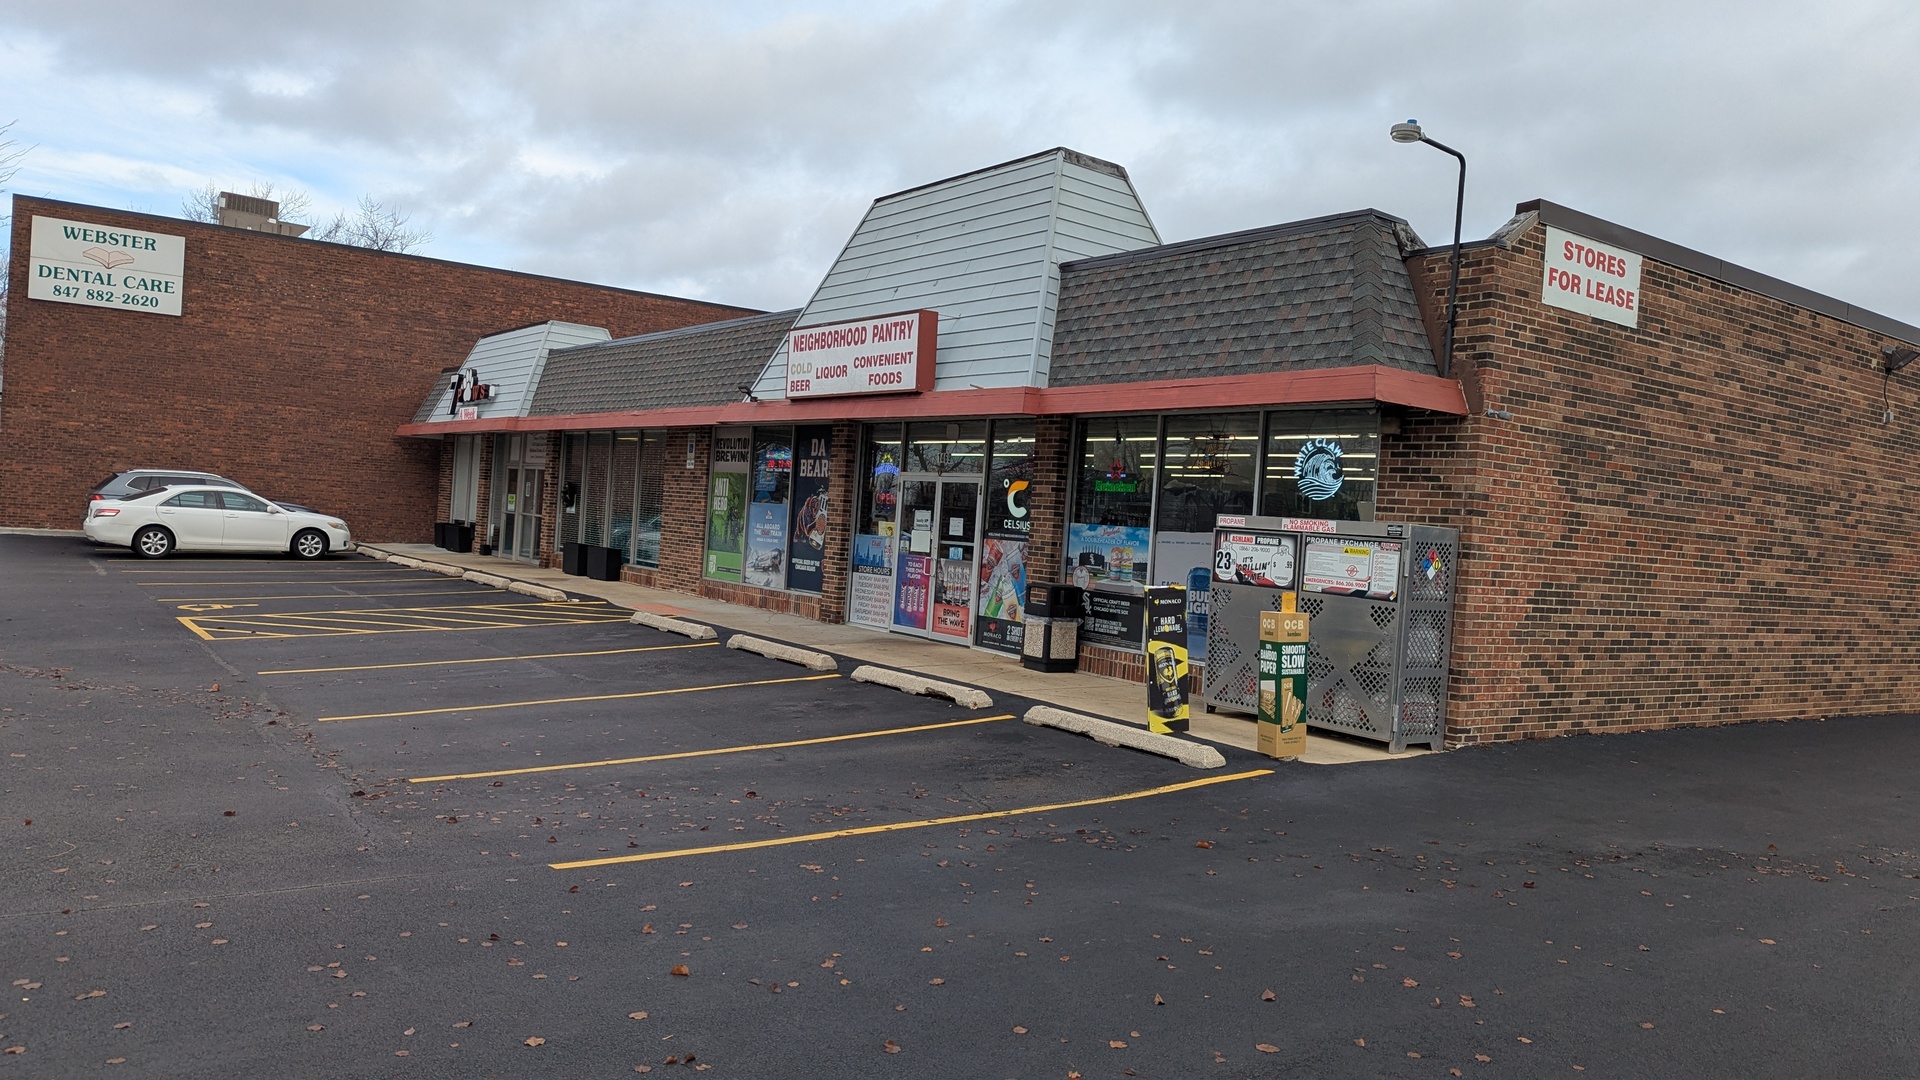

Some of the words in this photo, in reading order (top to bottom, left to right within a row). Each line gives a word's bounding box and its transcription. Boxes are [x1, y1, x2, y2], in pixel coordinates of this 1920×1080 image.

[62, 225, 157, 251] WEBSTER
[1563, 240, 1626, 278] STORES
[38, 264, 117, 287] DENTAL
[123, 275, 176, 294] CARE
[1547, 266, 1581, 295] FOR
[1585, 278, 1635, 311] LEASE
[52, 284, 80, 298] 847
[86, 289, 159, 308] 882-2620
[792, 325, 868, 353] NEIGHBORHOOD
[871, 319, 915, 344] PANTRY
[853, 351, 914, 369] CONVENIENT
[790, 362, 813, 376] COLD
[815, 364, 848, 380] LIQUOR
[868, 371, 902, 386] FOODS
[790, 379, 811, 392] BEER
[810, 438, 826, 457] DA
[1294, 440, 1314, 477] WHITE
[1315, 437, 1344, 458] CLAW
[800, 459, 830, 478] BEAR
[714, 477, 730, 497] ANTI
[1095, 480, 1136, 492] Heineken
[713, 496, 728, 511] HERO
[875, 492, 896, 505] OPEN
[764, 523, 780, 531] ABOARD
[1003, 519, 1031, 531] CELSIUS
[1219, 517, 1245, 525] PROPANE
[1299, 519, 1329, 527] SMOKING
[1283, 524, 1321, 532] FLAMMABLE
[1321, 525, 1335, 533] GAS
[1231, 535, 1253, 543] ASHLAND
[1256, 537, 1280, 545] PROPANE
[1306, 536, 1338, 545] PROPANE
[1339, 539, 1379, 549] EXCHANGE
[1216, 551, 1231, 570] 23
[1430, 551, 1435, 560] 4
[858, 565, 873, 574] STORE
[873, 567, 890, 576] HOURS
[1425, 559, 1430, 568] 2
[1434, 560, 1439, 570] 0
[1305, 577, 1335, 586] EMERGENCIES:
[1335, 579, 1367, 589] 866.206.9000
[1189, 590, 1210, 603] BUD
[943, 608, 960, 618] BRING
[937, 617, 948, 626] THE
[948, 618, 965, 628] WAVE
[1160, 615, 1176, 626] HARD
[1262, 618, 1275, 629] OCB
[1284, 619, 1304, 630] OCB
[983, 631, 1002, 639] MONACO
[1006, 625, 1011, 635] 2
[1155, 624, 1181, 633] LEMONADE
[1260, 649, 1277, 661] BAMBOO
[1281, 645, 1306, 655] SMOOTH
[1260, 660, 1277, 675] PAPER
[1281, 654, 1305, 669] SLOW
